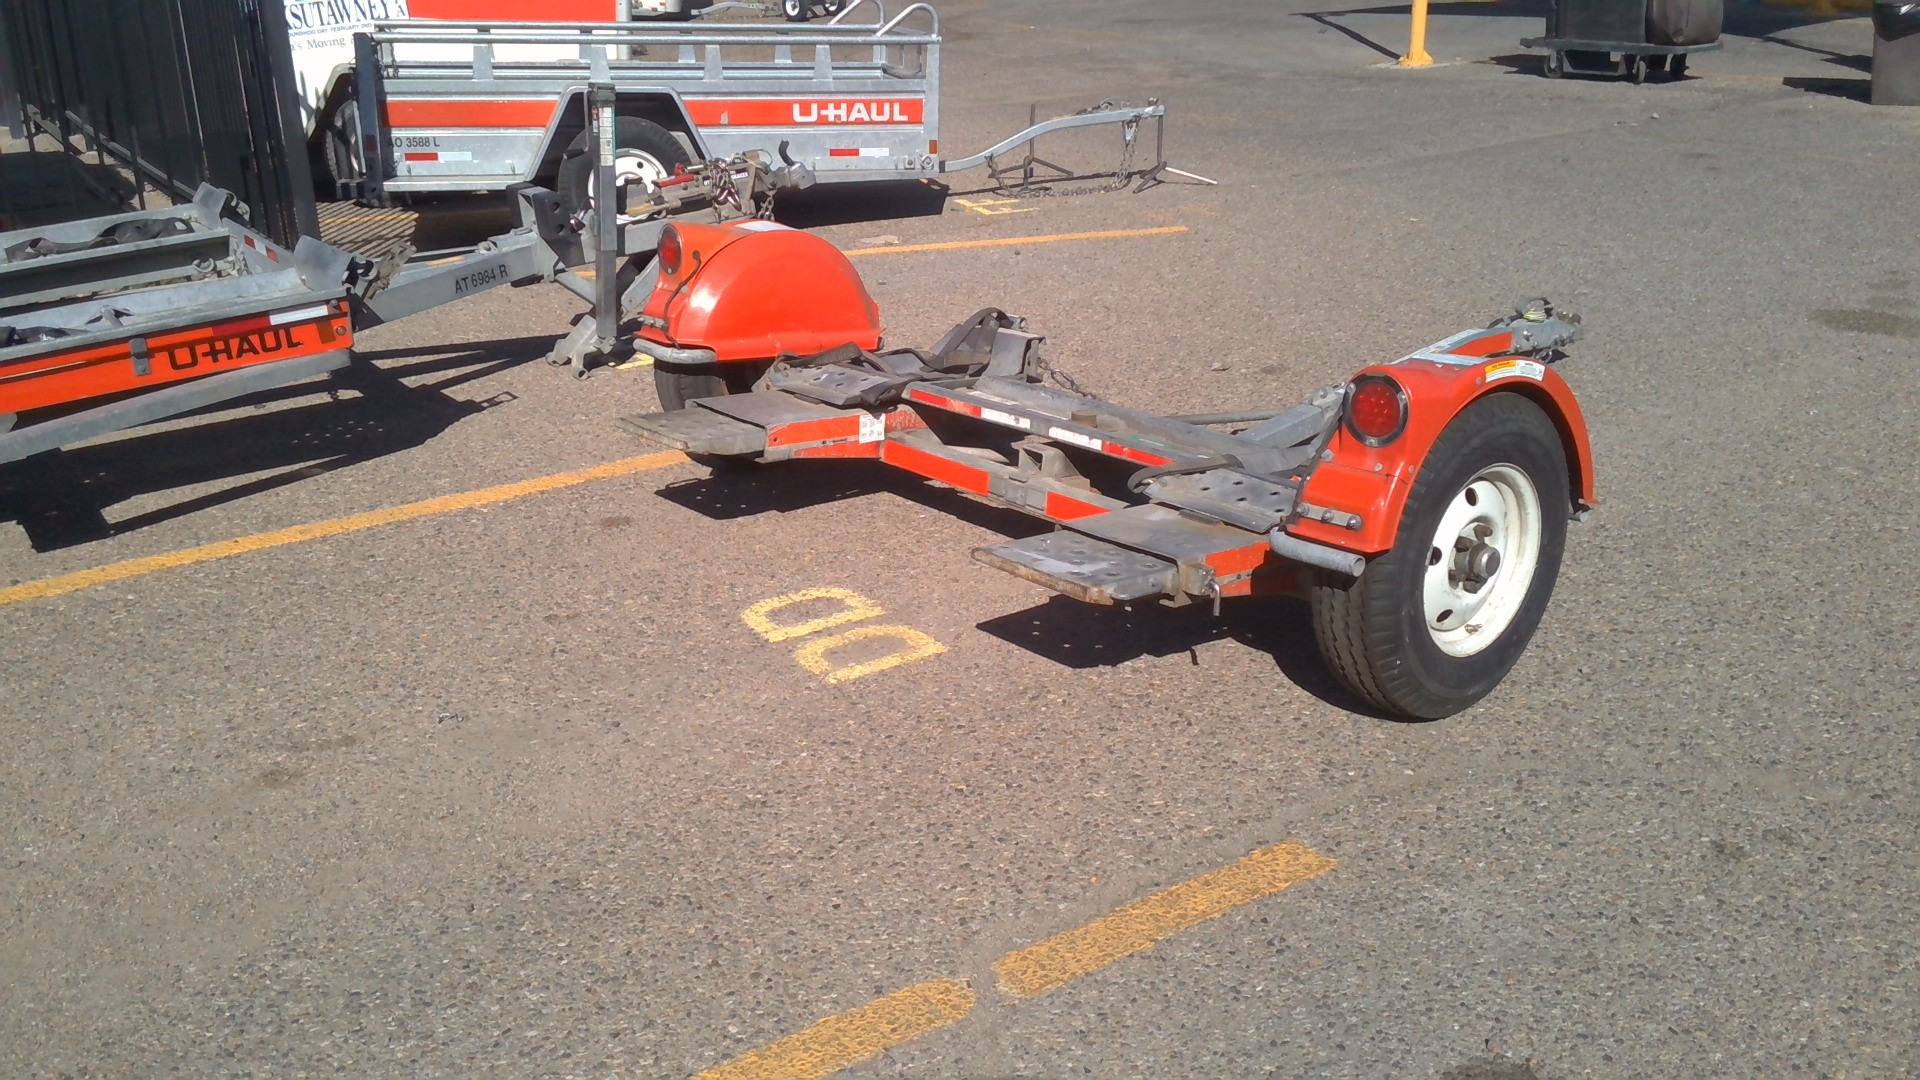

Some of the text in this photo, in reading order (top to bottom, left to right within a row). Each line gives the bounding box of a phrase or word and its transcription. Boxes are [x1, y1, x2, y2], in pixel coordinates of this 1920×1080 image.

[306, 37, 346, 50] Moving
[793, 102, 908, 122] U-HAUL
[406, 137, 430, 147] 3588
[433, 137, 440, 147] L
[456, 264, 508, 294] AT 6984 R
[167, 328, 304, 371] U-HAUL
